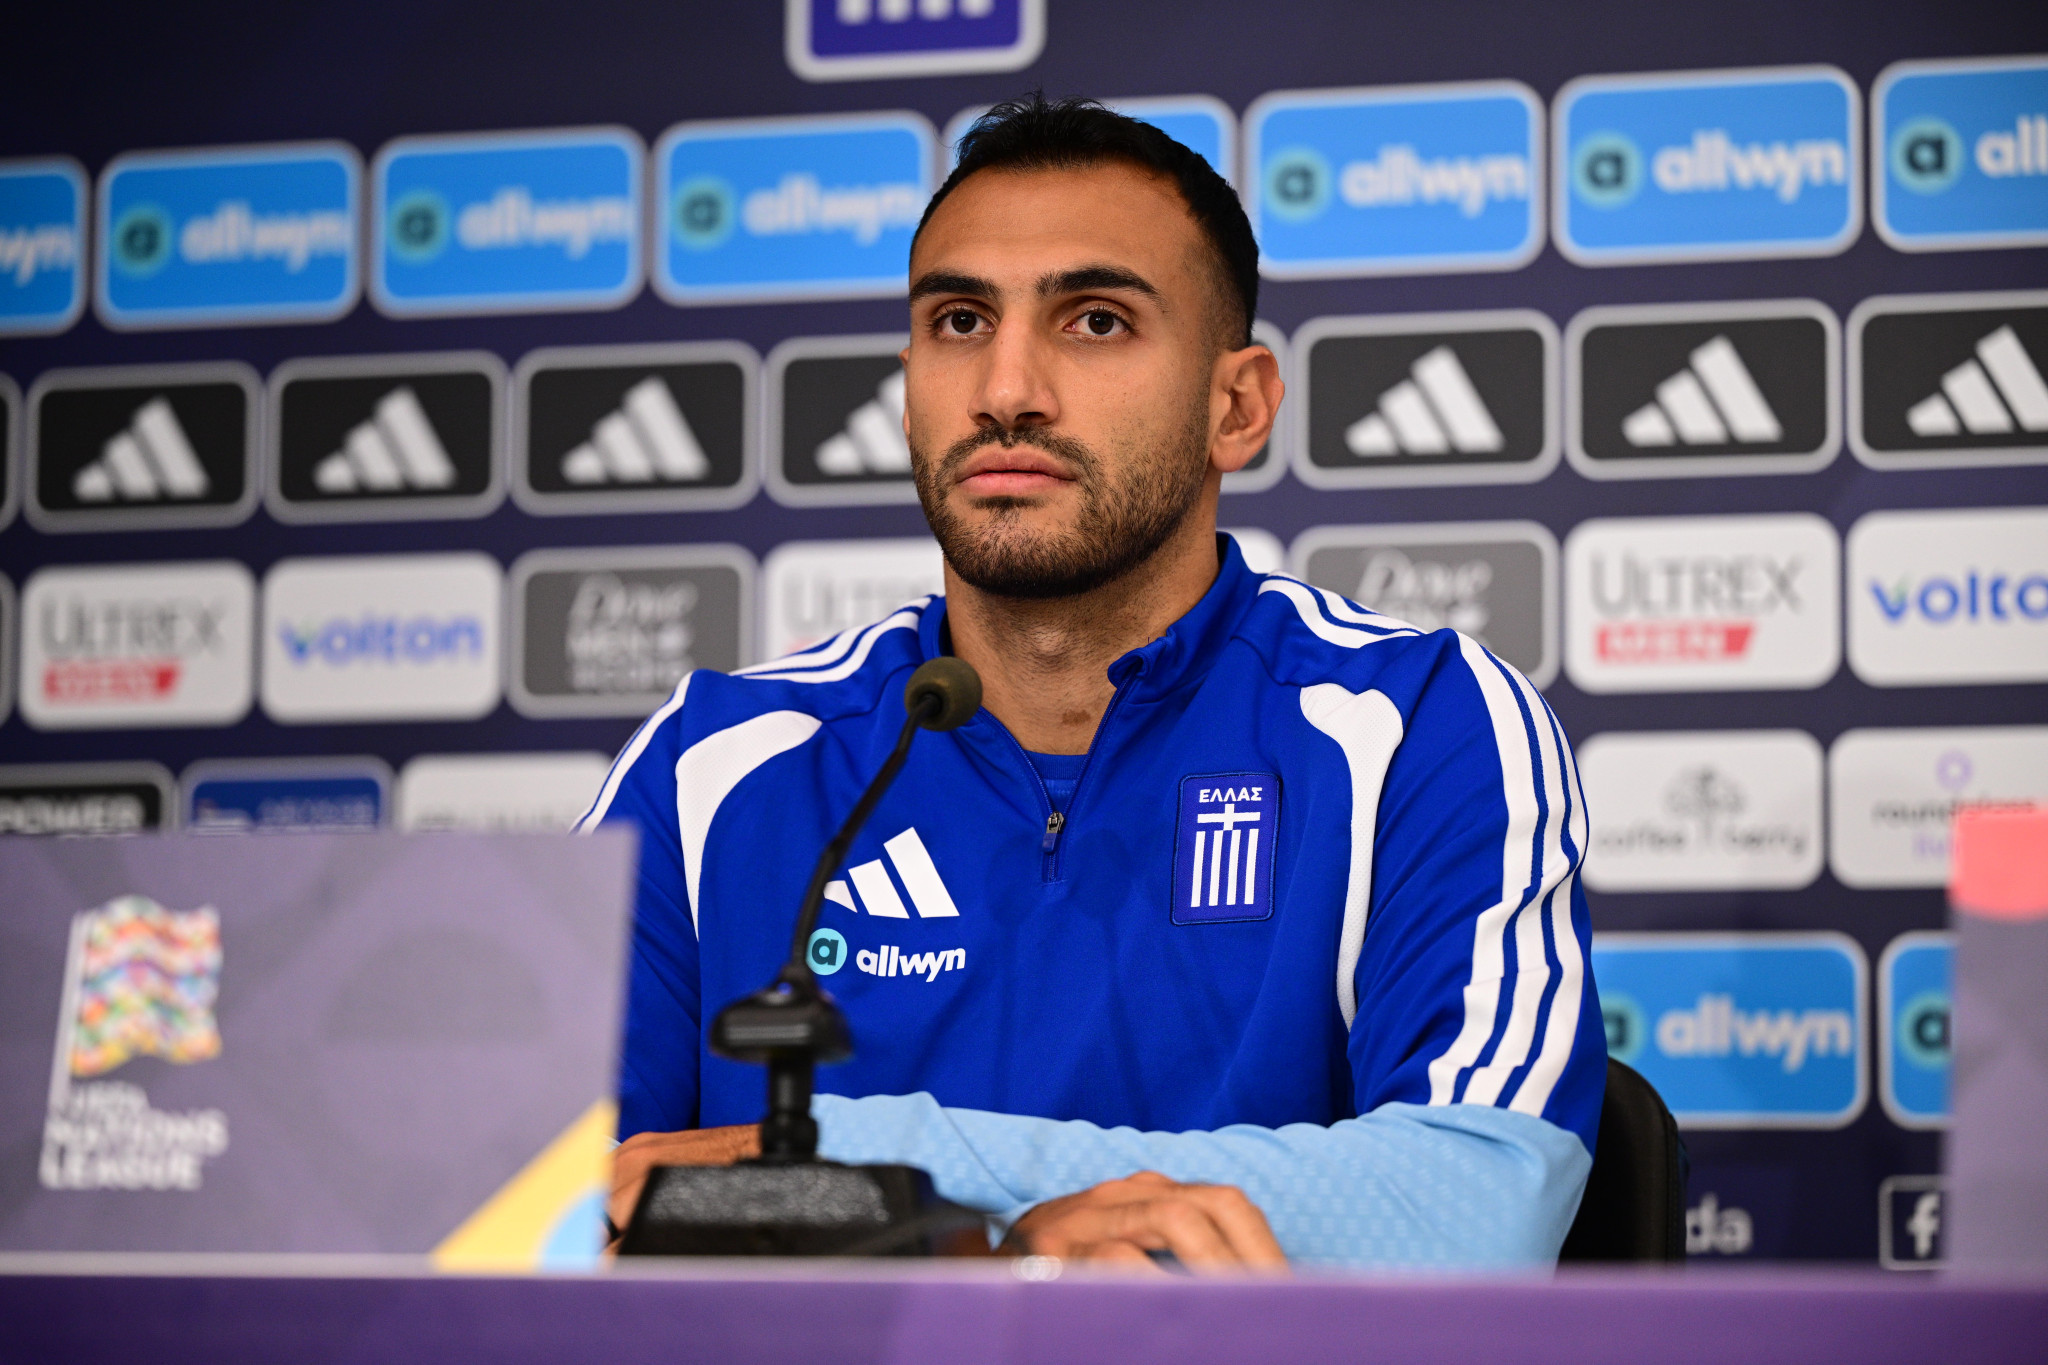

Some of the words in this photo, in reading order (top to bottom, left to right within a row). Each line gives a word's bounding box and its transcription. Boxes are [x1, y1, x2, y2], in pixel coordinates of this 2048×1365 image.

[1340, 143, 1529, 218] allwyn
[1652, 129, 1847, 204] allwyn
[1590, 548, 1804, 616] ULTREX
[1199, 787, 1262, 803] ΕΛΛΑΣ
[856, 945, 966, 983] allwyn
[1655, 994, 1852, 1073] allwyn
